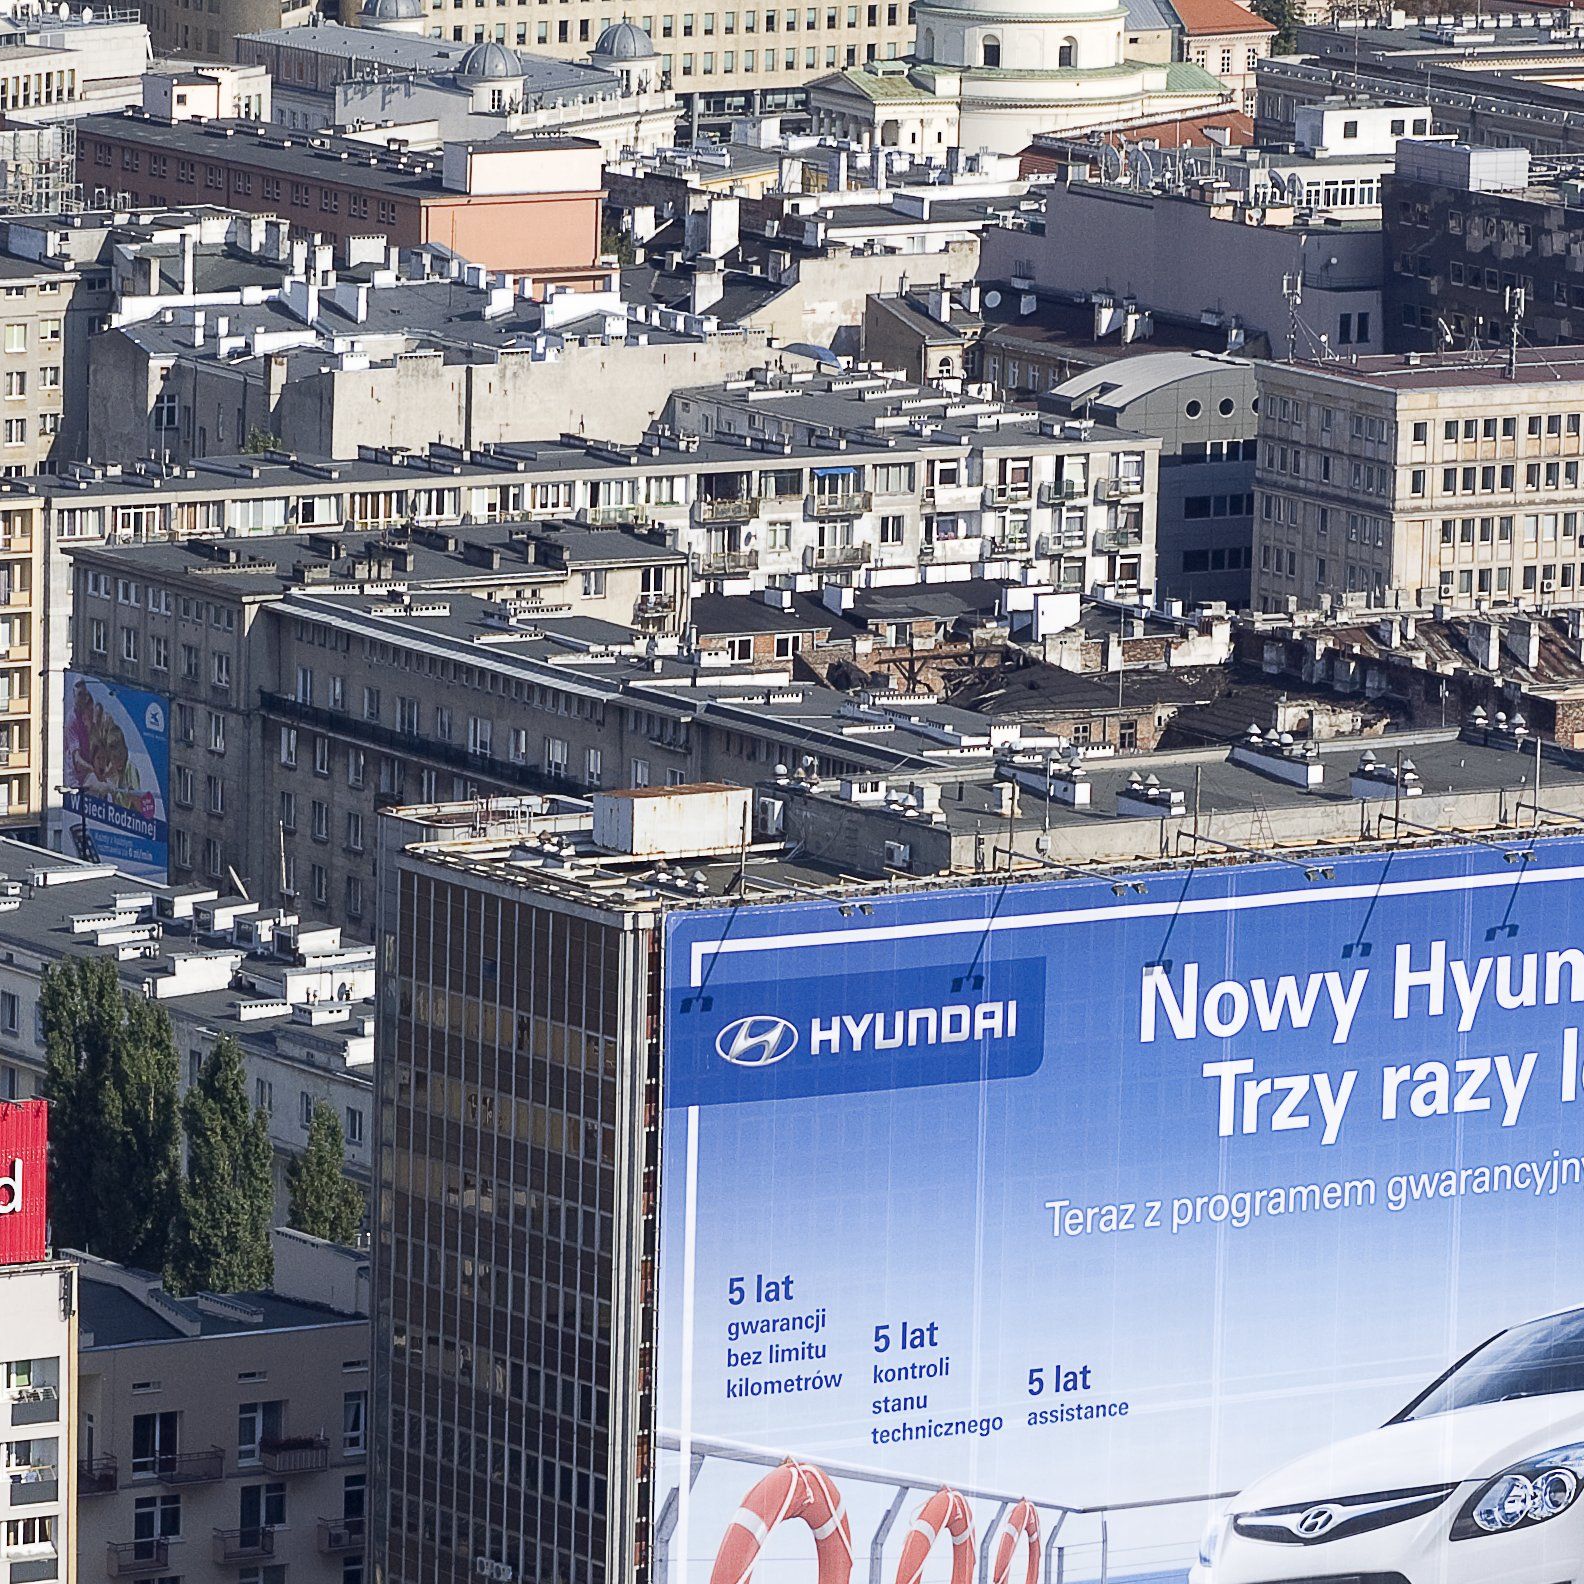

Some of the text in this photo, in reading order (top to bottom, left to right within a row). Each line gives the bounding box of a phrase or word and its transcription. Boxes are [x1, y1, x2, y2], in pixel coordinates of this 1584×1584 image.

[108, 806, 157, 840] Rodzinnej
[1141, 960, 1371, 1048] Nowy
[811, 1001, 1017, 1054] HYUNDAI
[1204, 1058, 1355, 1145] Trzy
[1382, 1048, 1535, 1128] razy
[1046, 1190, 1134, 1238] Teraz
[1144, 1200, 1163, 1227] z
[1174, 1170, 1375, 1238] programem
[728, 1273, 795, 1306] 5 lat
[727, 1308, 827, 1342] gwarancji
[873, 1320, 939, 1354] 5 lat
[727, 1341, 827, 1368] bez limitu
[872, 1356, 950, 1385] kontroli
[726, 1369, 843, 1399] kilometrów
[1027, 1363, 1092, 1396] 5 lat
[871, 1392, 929, 1415] stanu
[1027, 1400, 1130, 1427] assistance
[870, 1414, 1004, 1446] technicznego
